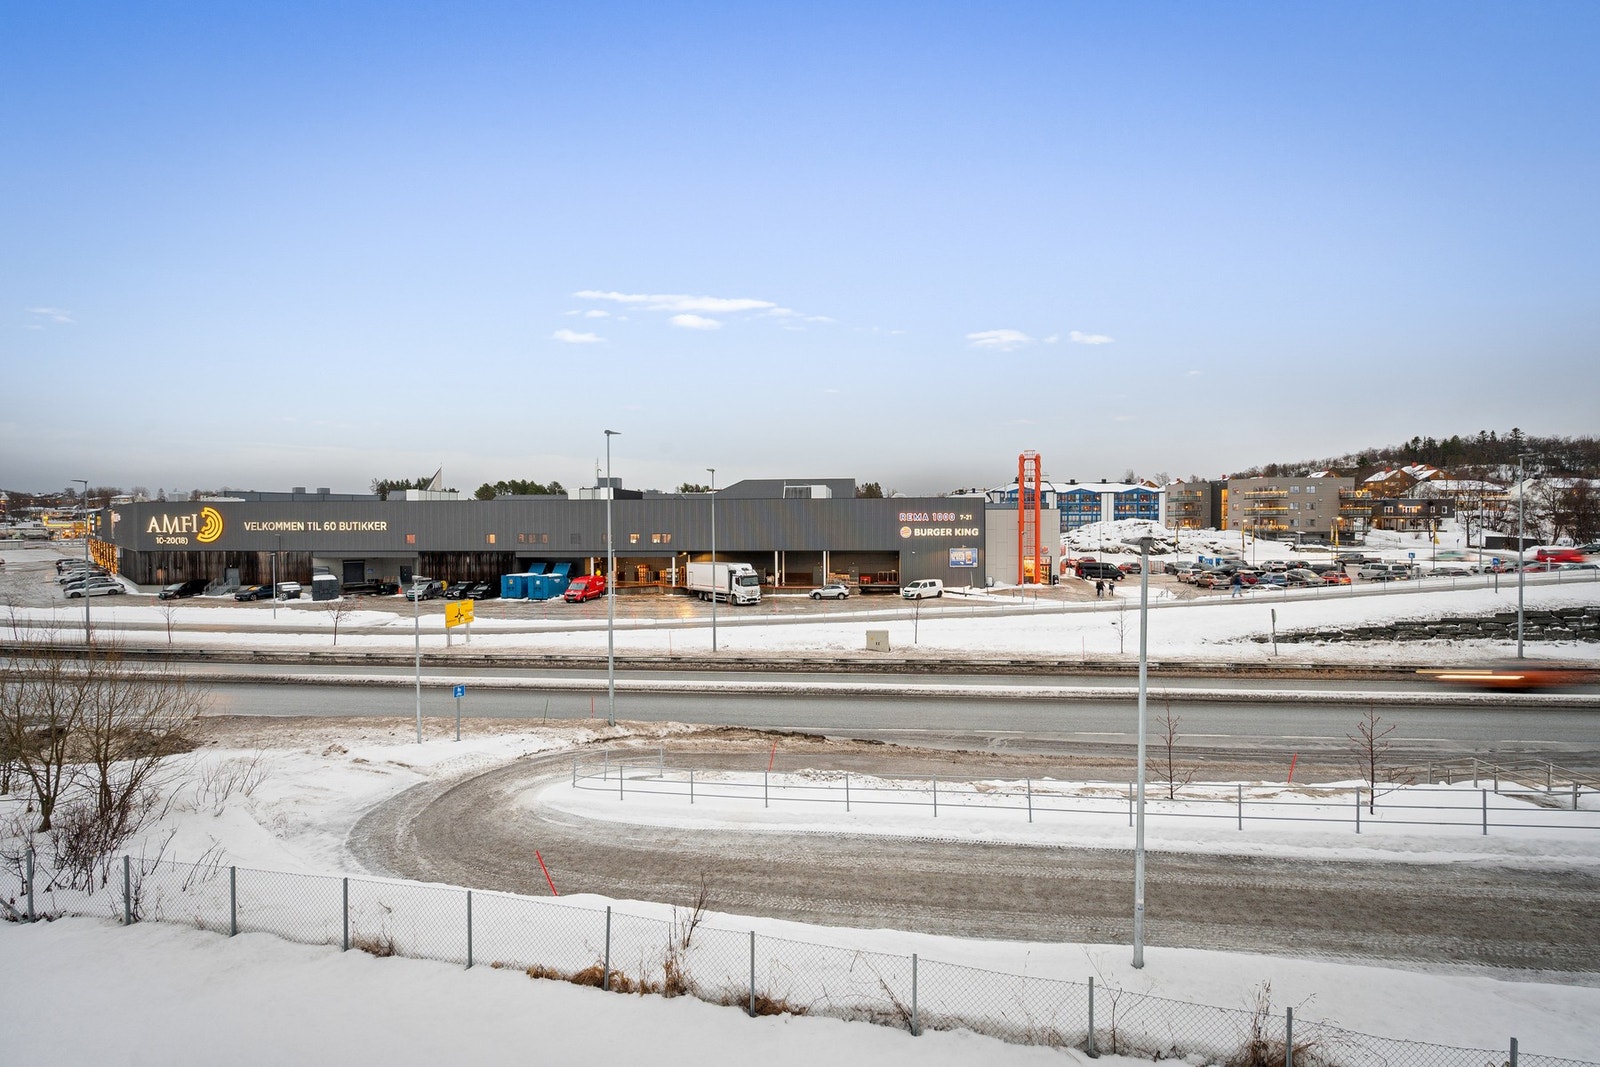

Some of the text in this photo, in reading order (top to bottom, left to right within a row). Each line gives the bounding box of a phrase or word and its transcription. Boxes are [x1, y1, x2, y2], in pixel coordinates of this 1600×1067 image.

[899, 513, 929, 521] REMA
[932, 513, 956, 521] 1000
[146, 513, 199, 535] AMFI
[243, 521, 387, 531] VELKOMMEN TIL 60 BUTIKKER
[914, 528, 952, 536] BURGER
[954, 528, 979, 536] KING
[155, 536, 189, 545] 10-20(18)
